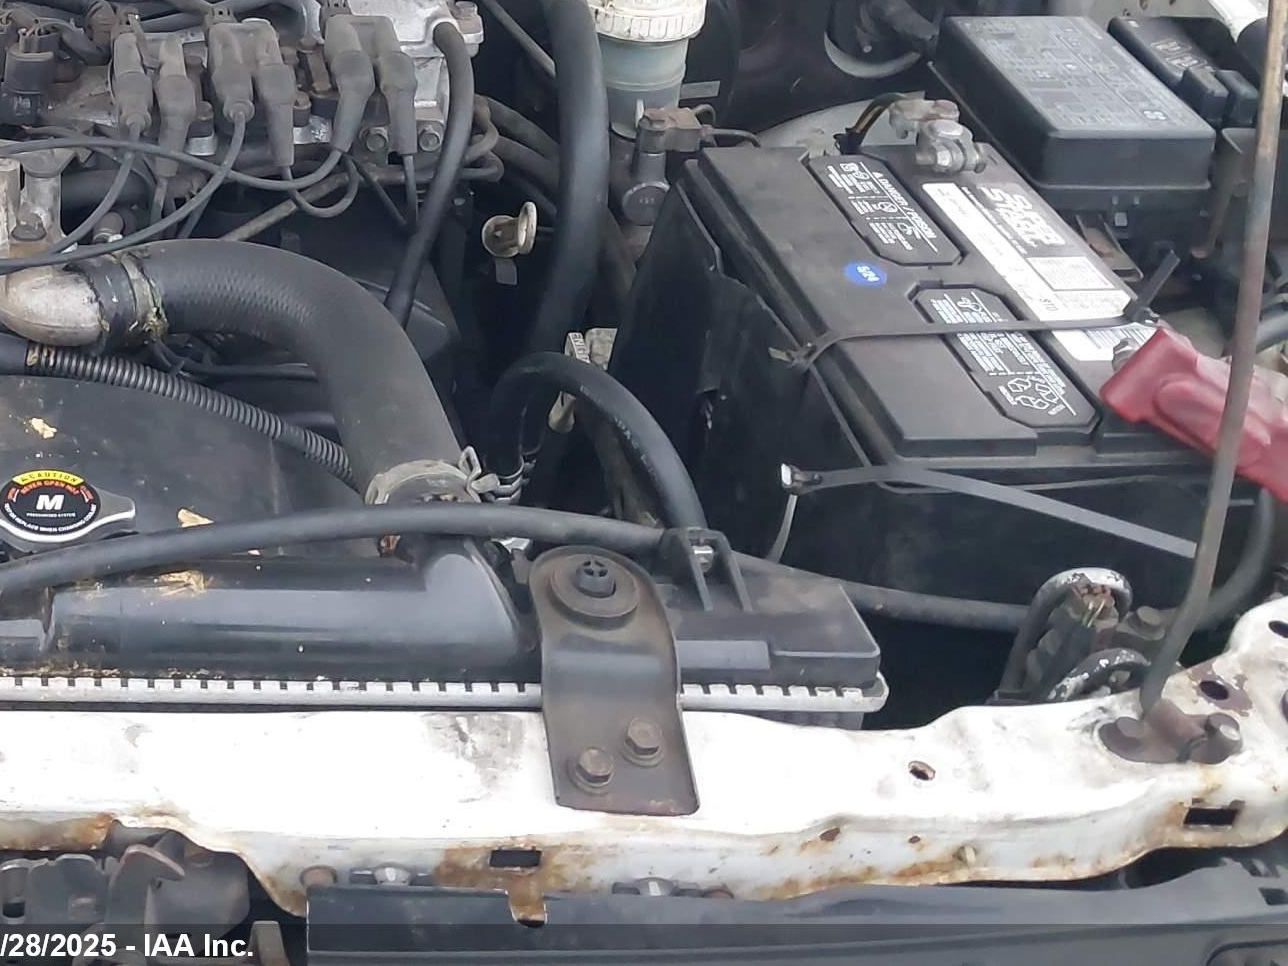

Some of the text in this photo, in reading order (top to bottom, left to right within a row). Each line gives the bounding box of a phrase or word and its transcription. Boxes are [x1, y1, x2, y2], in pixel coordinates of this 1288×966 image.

[879, 178, 908, 207] DANGER
[29, 472, 78, 482] CAUTION
[44, 480, 65, 489] OPEN
[35, 494, 65, 511] M
